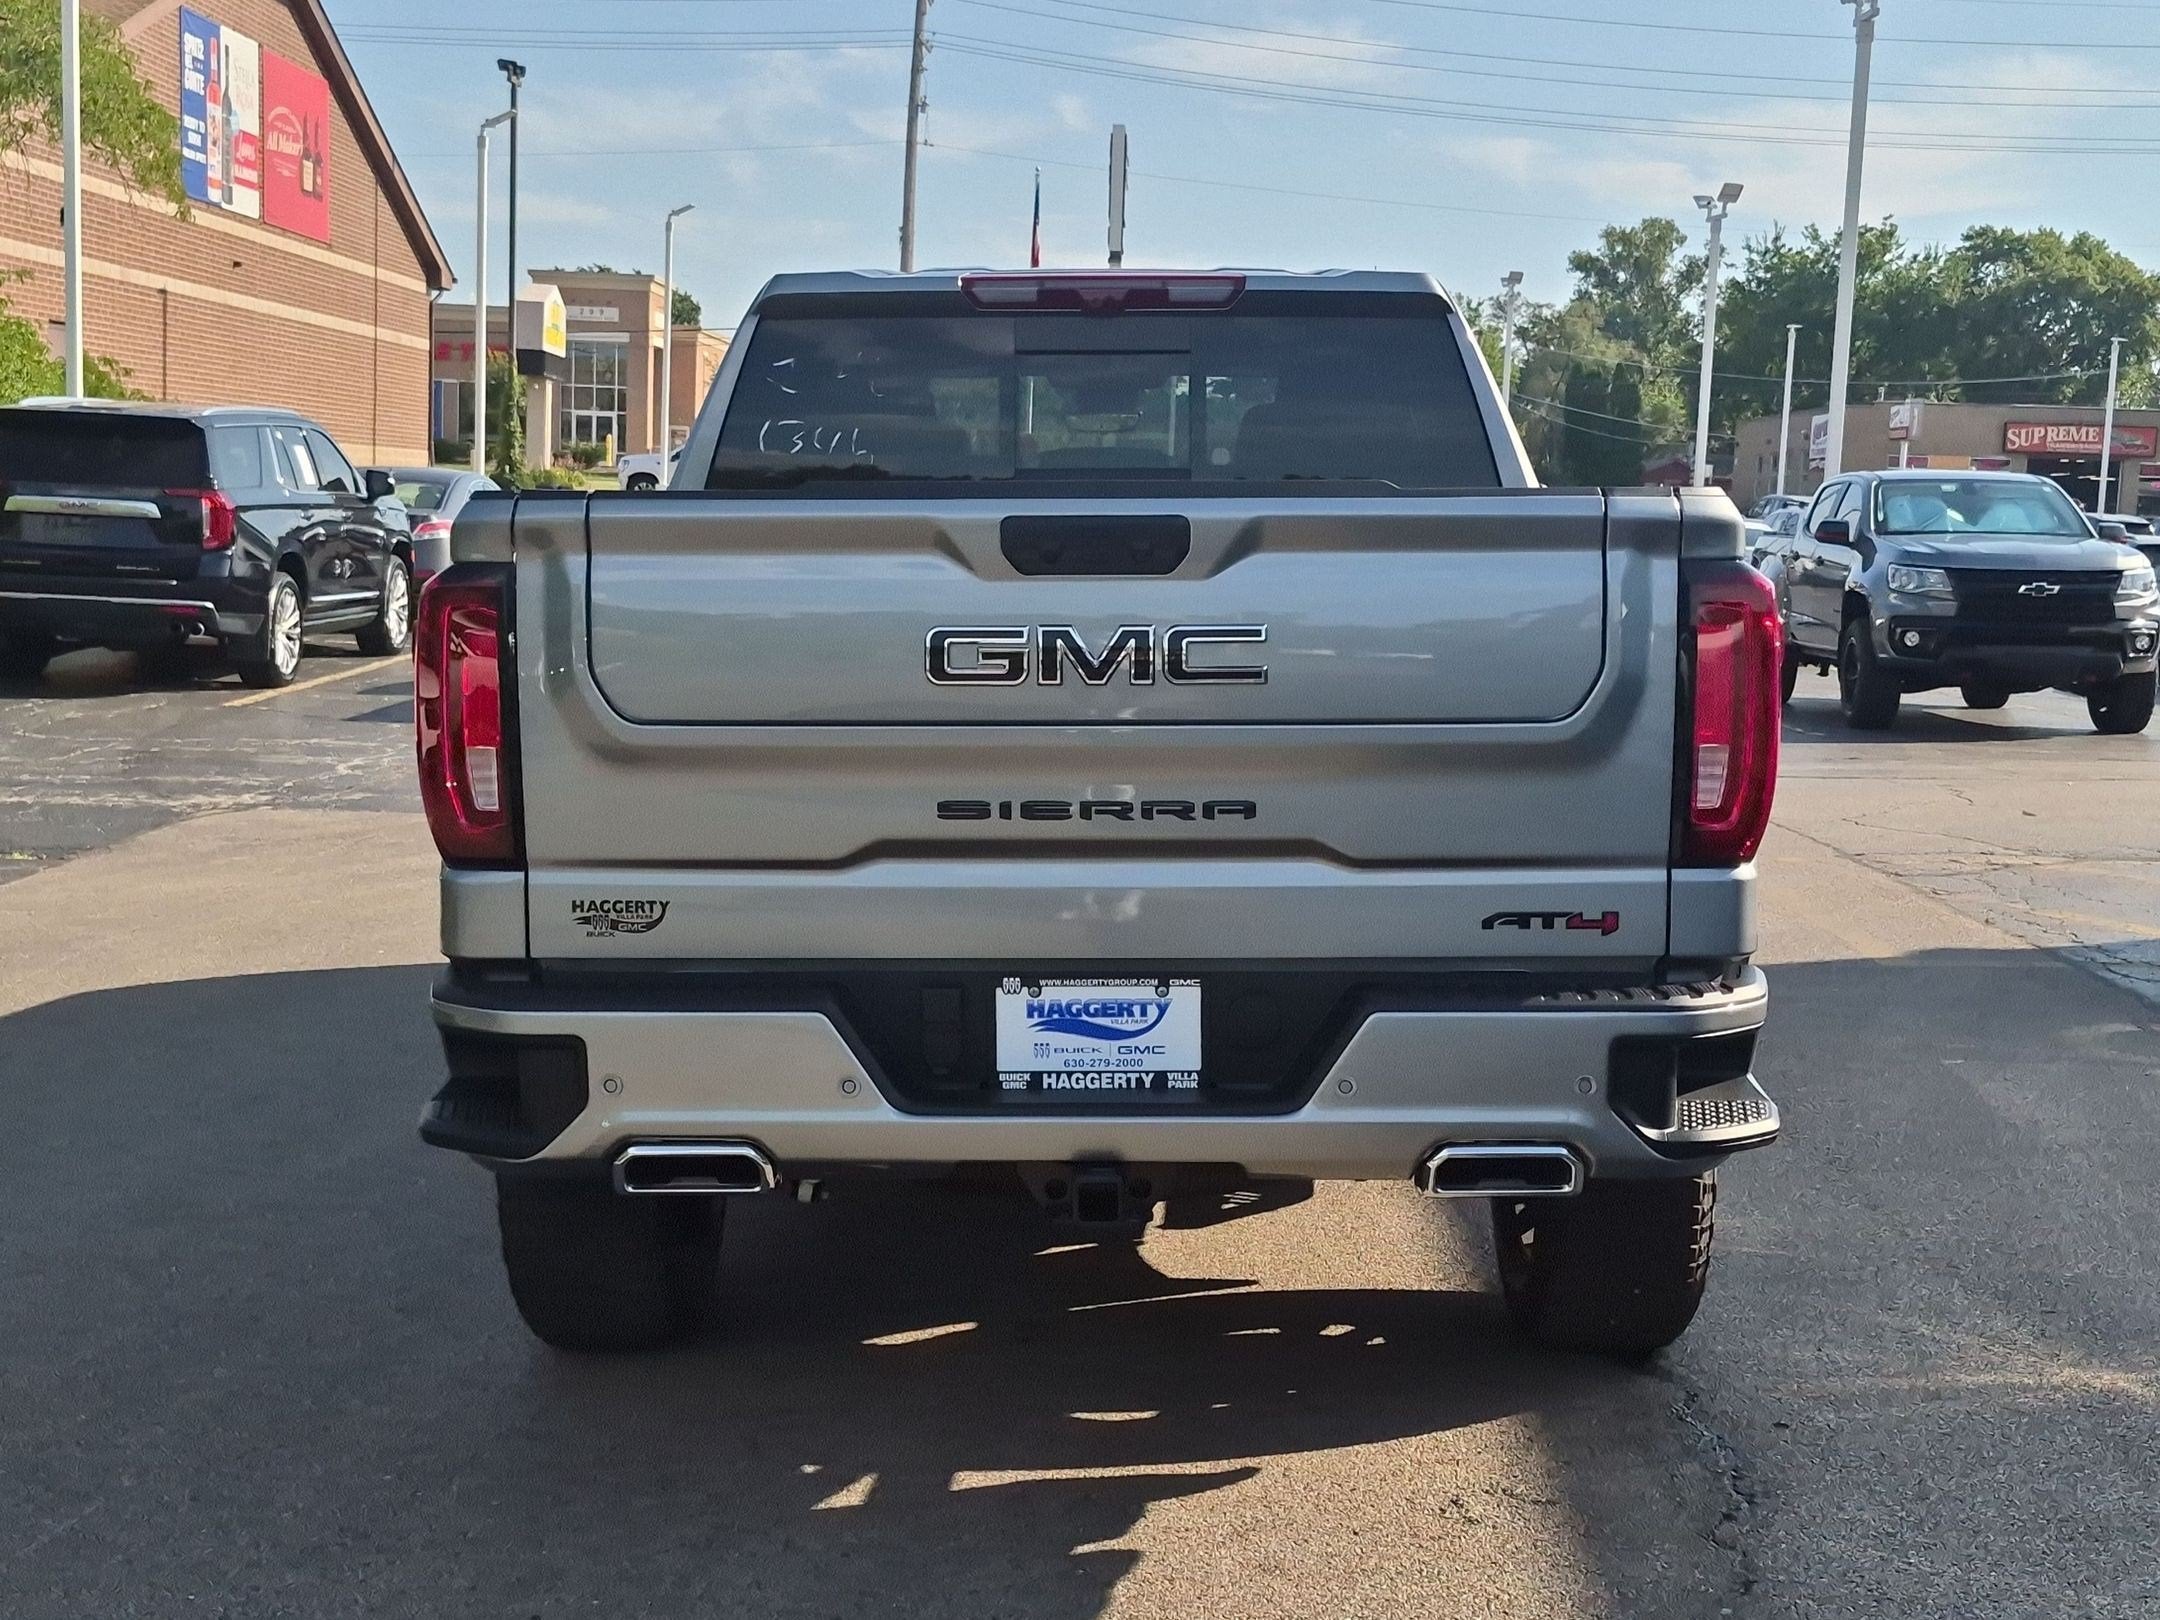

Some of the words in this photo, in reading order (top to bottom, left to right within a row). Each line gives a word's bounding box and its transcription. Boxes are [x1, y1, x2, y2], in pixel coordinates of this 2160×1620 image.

[2007, 426, 2100, 449] SUPREME
[924, 624, 1268, 686] GMC
[936, 800, 1257, 821] SIERRA
[572, 899, 671, 915] HAGGERTY
[618, 923, 648, 931] GMC
[1481, 911, 1620, 936] AT4
[1039, 978, 1159, 986] WWW.HAGGERTYGROUP.COM
[1026, 998, 1173, 1019] HAGGERTY
[1117, 1045, 1166, 1054] GMC
[1063, 1058, 1144, 1068] 630-279-2000
[999, 1073, 1031, 1081] BUICK
[1042, 1073, 1154, 1089] HAGGERTY
[1167, 1072, 1199, 1081] VILLA
[1002, 1081, 1028, 1089] GMC
[1167, 1081, 1199, 1089] PARK
